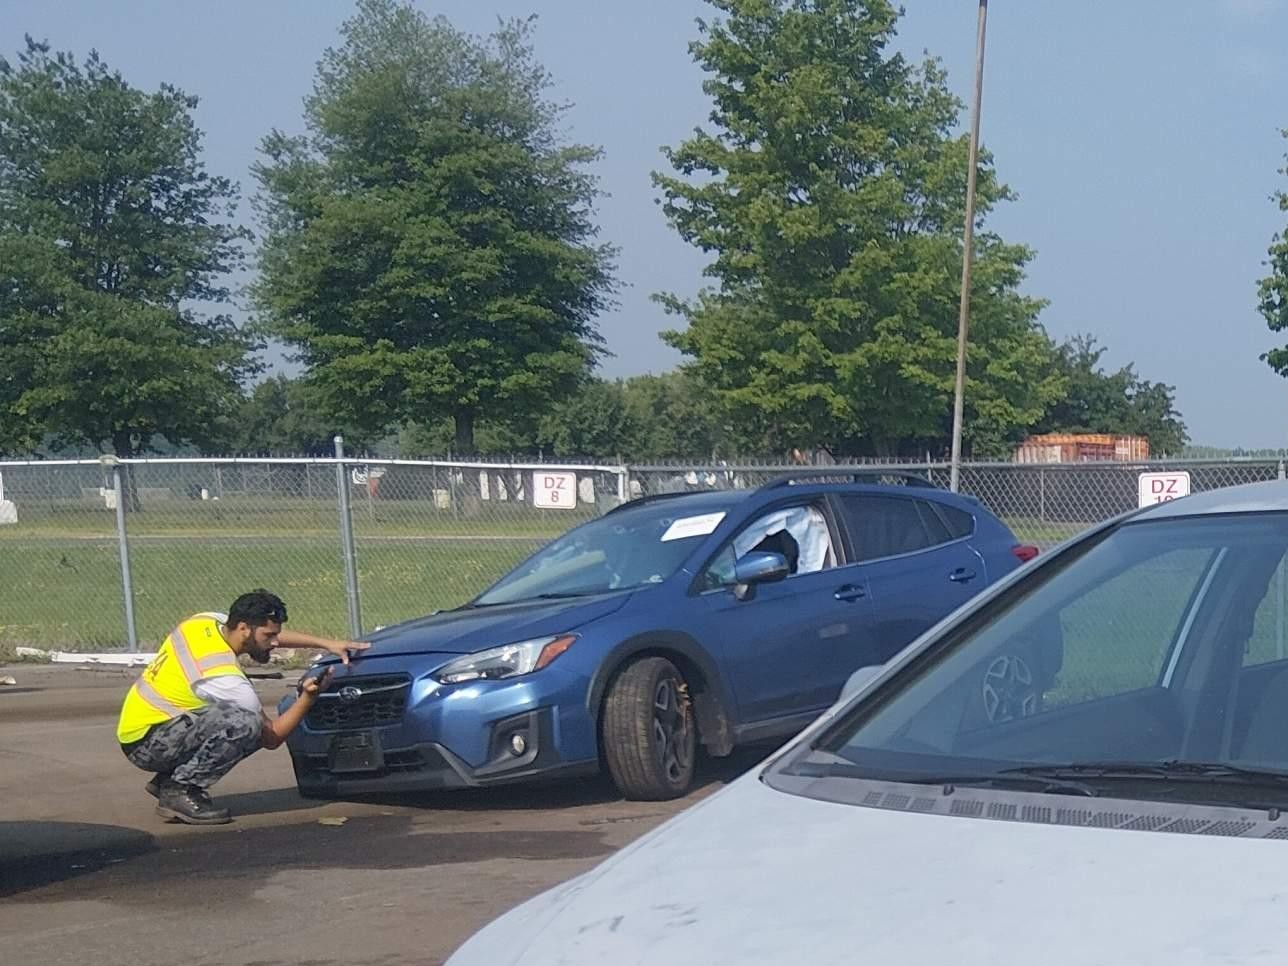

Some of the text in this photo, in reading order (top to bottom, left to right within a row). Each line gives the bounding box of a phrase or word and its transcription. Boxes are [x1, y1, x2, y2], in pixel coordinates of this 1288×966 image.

[544, 476, 567, 490] DZ
[1151, 479, 1178, 494] DZ
[551, 490, 559, 503] 8
